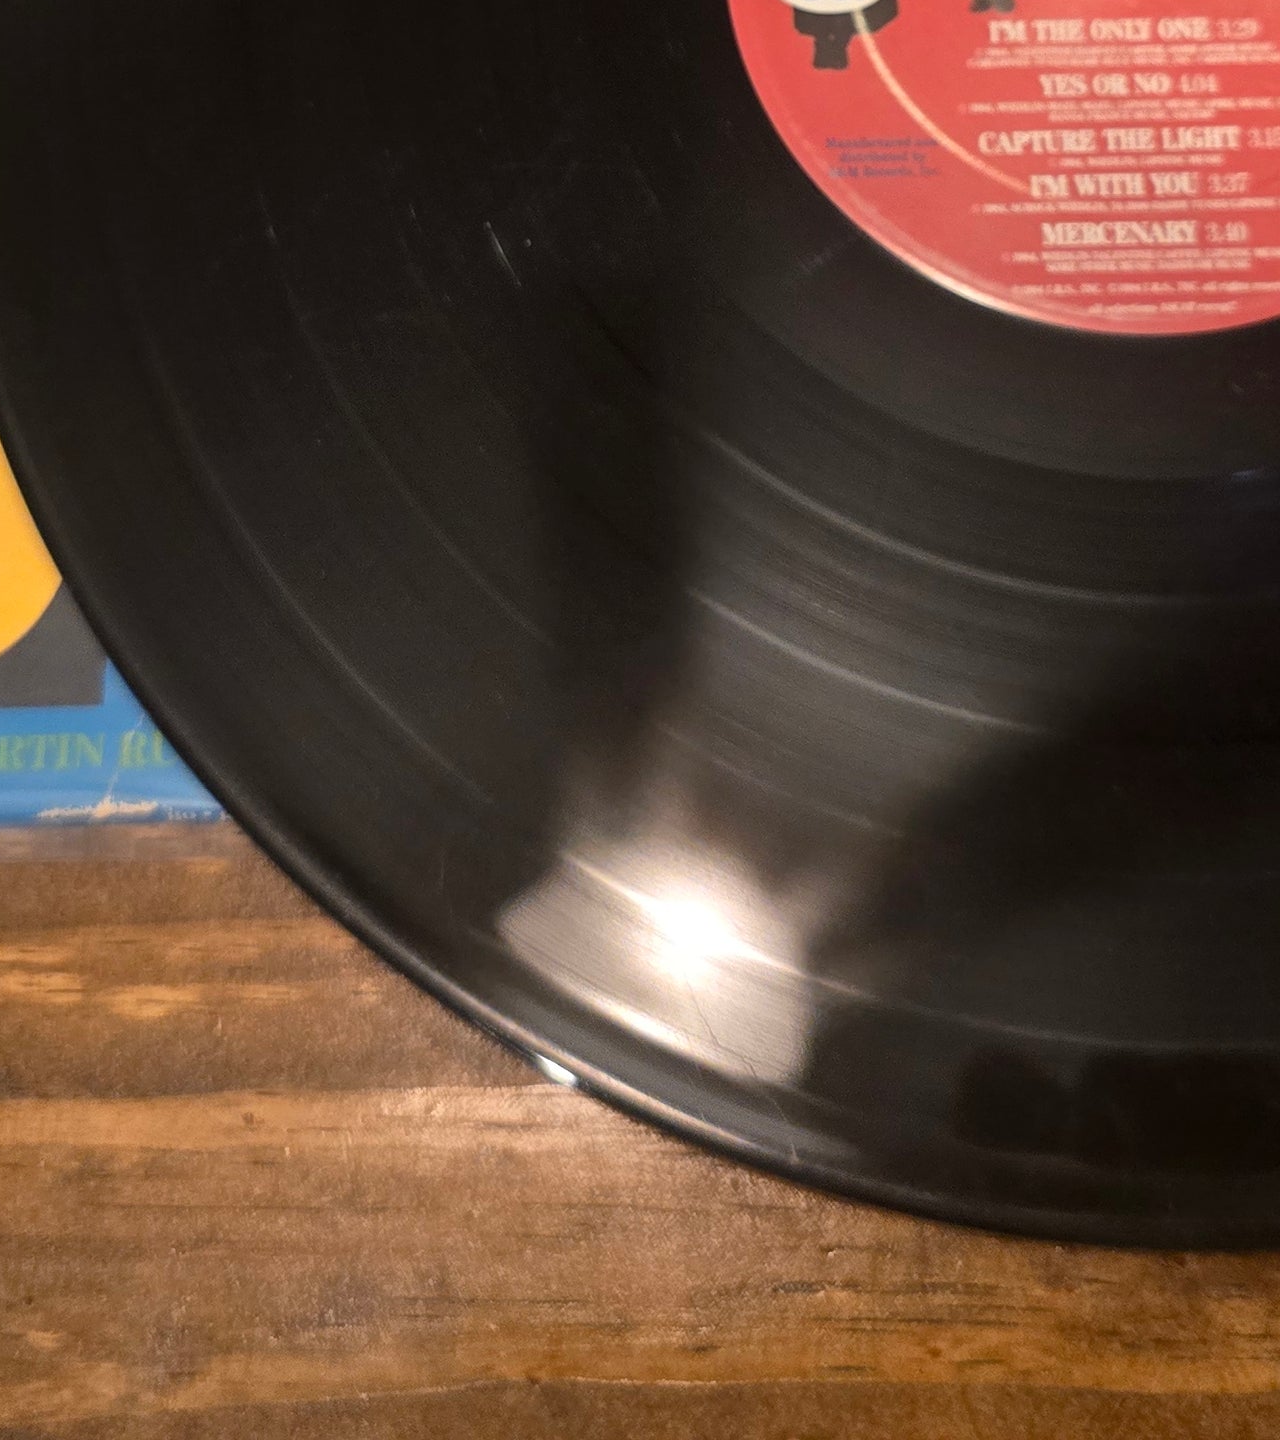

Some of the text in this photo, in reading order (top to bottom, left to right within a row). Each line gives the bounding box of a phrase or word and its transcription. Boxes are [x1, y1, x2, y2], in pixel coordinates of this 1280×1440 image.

[988, 19, 1027, 43] I'M
[1031, 19, 1085, 43] THE
[1089, 17, 1153, 42] ONLY
[1157, 16, 1210, 41] ONE
[1039, 72, 1088, 98] YES
[1091, 72, 1130, 97] OR
[1132, 71, 1172, 96] NO
[978, 128, 1097, 155] CAPTURE
[1102, 127, 1156, 152] THE
[1161, 125, 1242, 151] LIGHT
[1029, 173, 1069, 199] I'M
[1073, 172, 1147, 197] WITH
[1148, 171, 1201, 196] YOU
[1040, 219, 1199, 247] MERCENARY
